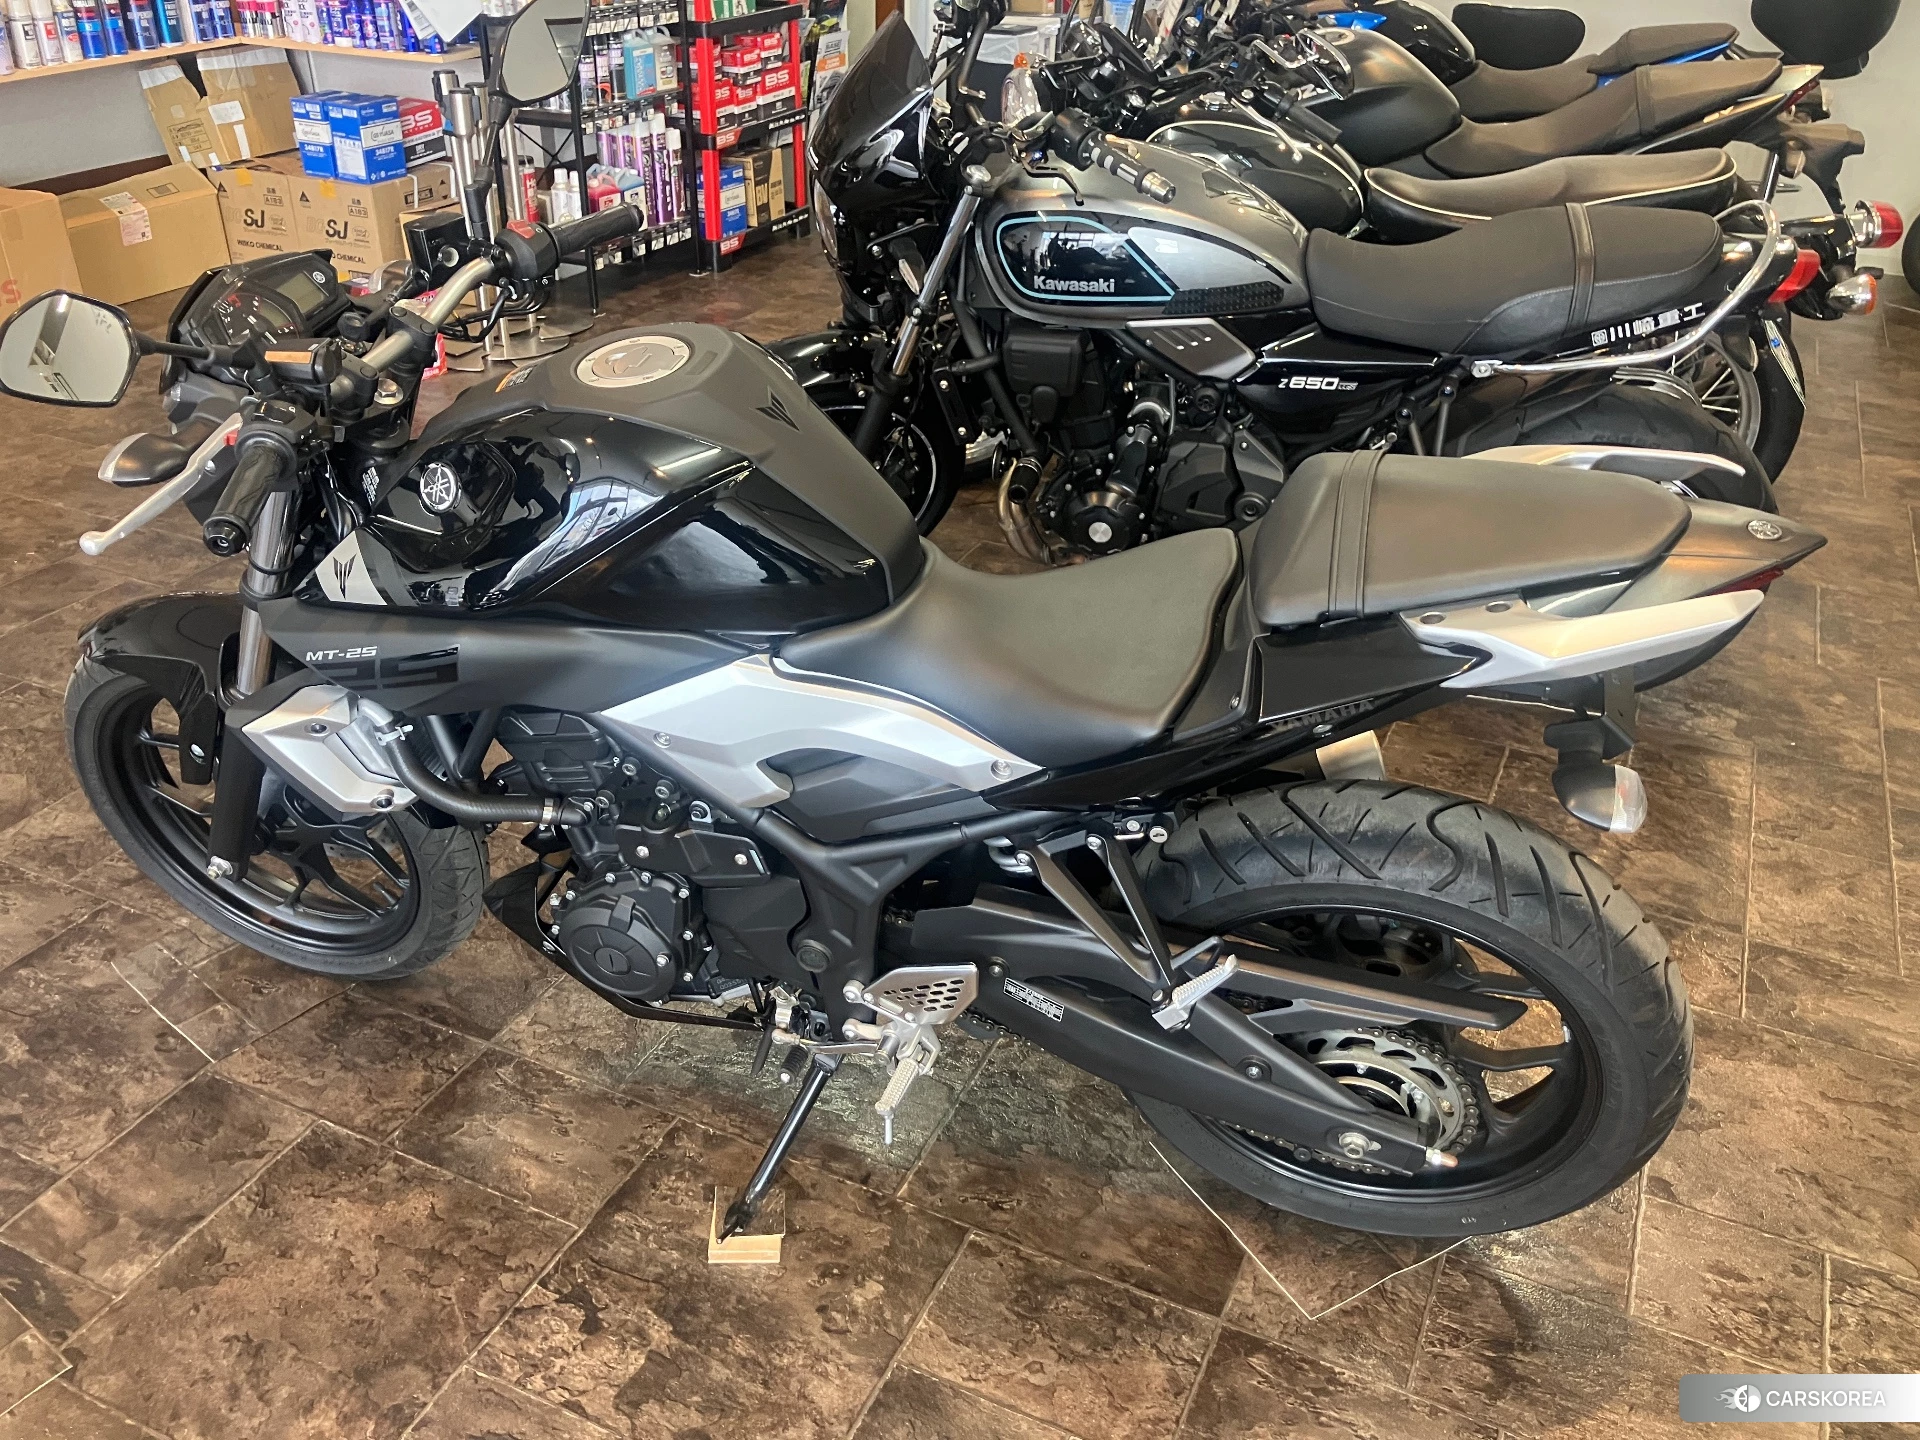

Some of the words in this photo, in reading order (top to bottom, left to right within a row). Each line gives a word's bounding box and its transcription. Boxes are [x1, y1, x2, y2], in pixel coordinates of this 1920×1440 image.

[766, 70, 790, 85] BS
[717, 132, 735, 146] BS
[243, 208, 266, 229] SJ
[325, 218, 349, 240] SJ
[720, 237, 740, 251] BS
[336, 252, 366, 264] CHEMICAL
[1034, 275, 1115, 293] Kawasaki
[306, 646, 378, 662] MT-25
[1271, 699, 1377, 734] YAMAHA
